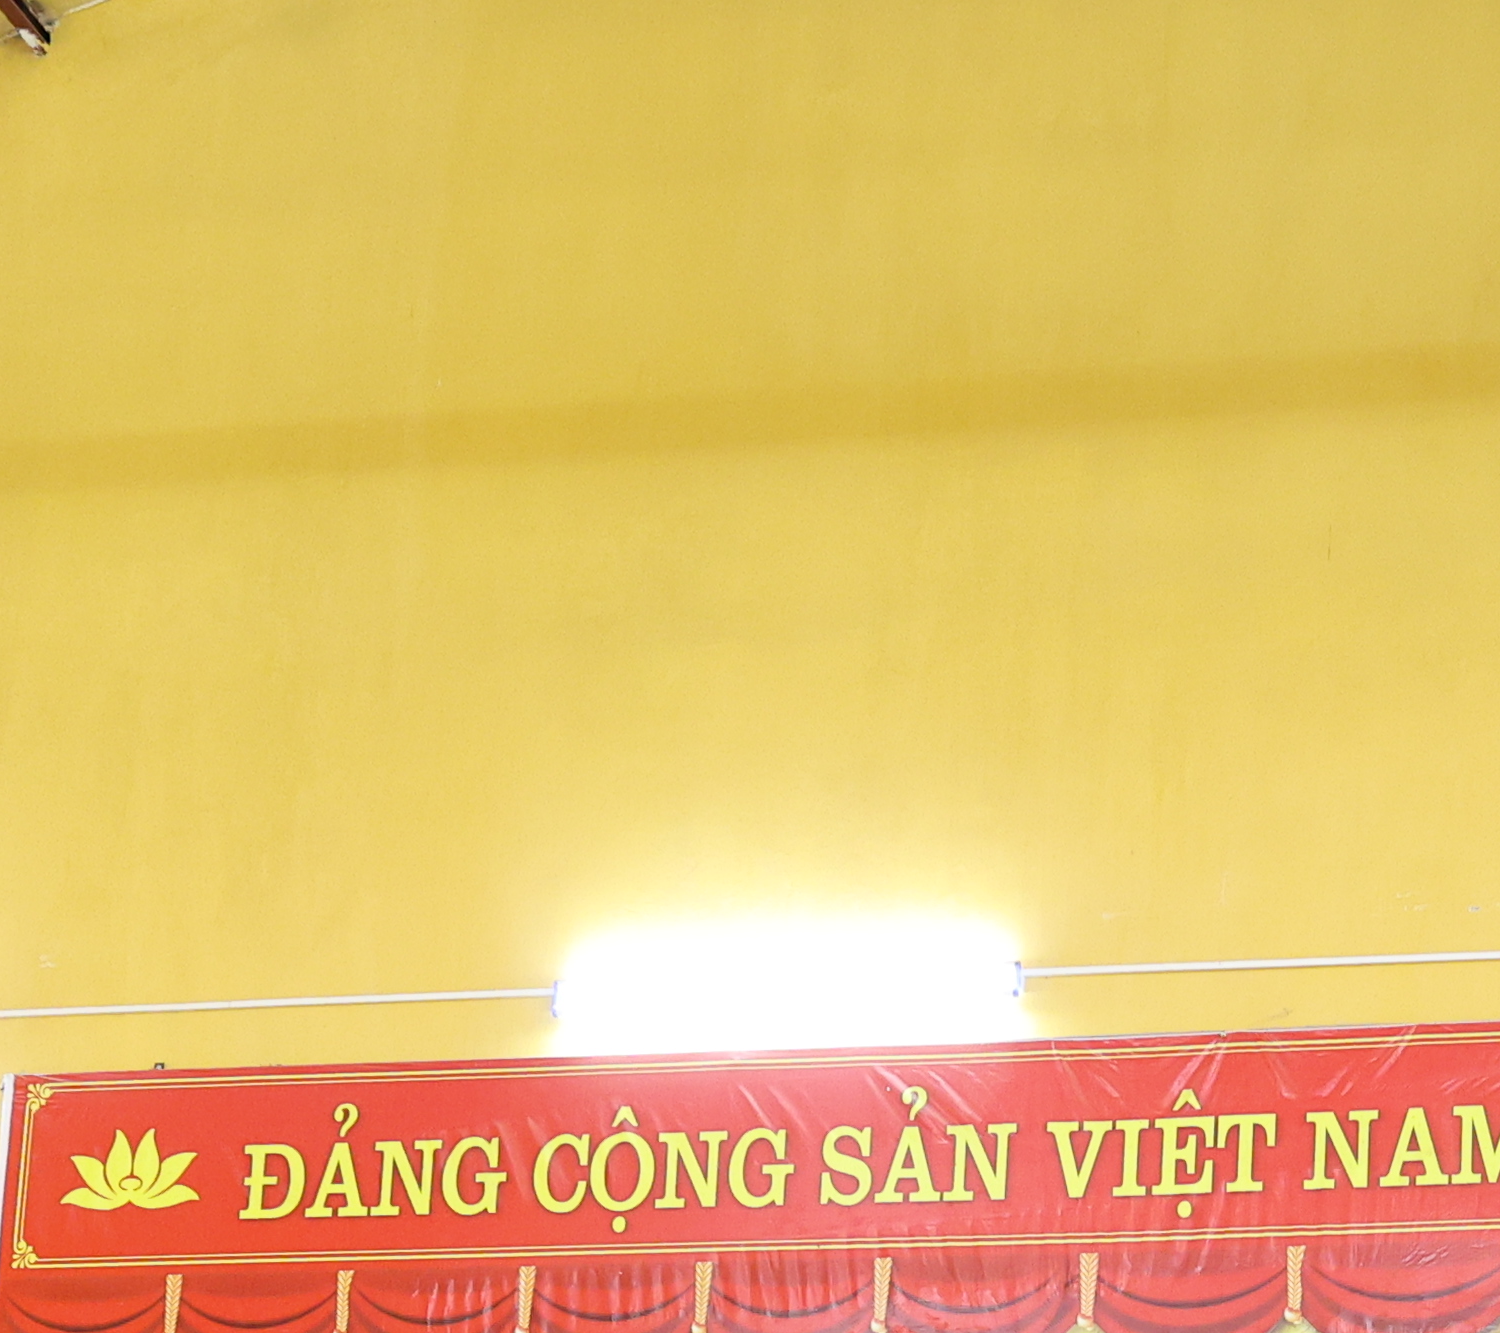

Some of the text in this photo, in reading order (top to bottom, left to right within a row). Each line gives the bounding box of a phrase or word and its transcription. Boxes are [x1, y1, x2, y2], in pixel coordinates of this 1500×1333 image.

[240, 1103, 508, 1220] ĐẢNG
[532, 1105, 796, 1233] CỘNG
[817, 1085, 1019, 1206] SẢN
[1047, 1090, 1279, 1219] VIỆT
